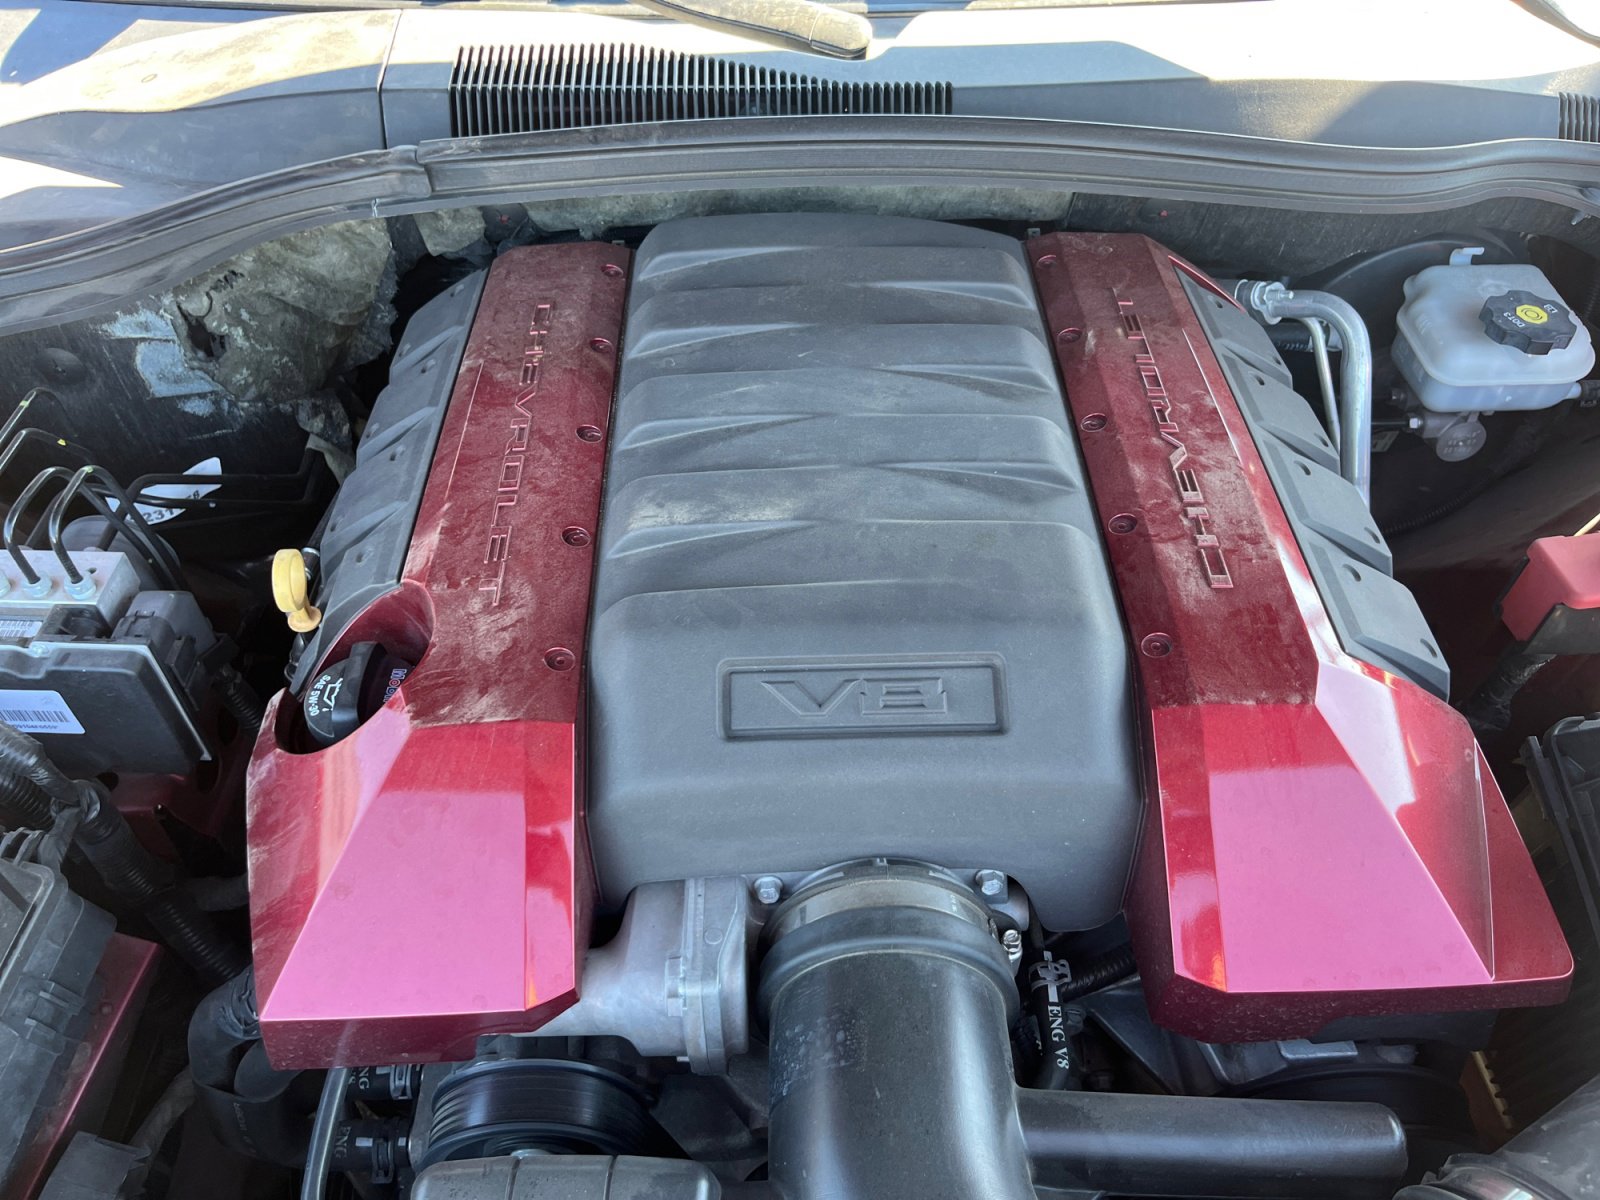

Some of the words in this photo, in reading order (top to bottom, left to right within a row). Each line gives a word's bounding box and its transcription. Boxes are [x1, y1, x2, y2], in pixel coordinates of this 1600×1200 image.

[1503, 311, 1526, 328] DOT3
[1111, 286, 1234, 590] CHEVROLET
[478, 304, 551, 607] CHEVROLET
[313, 674, 332, 690] SAE
[308, 690, 321, 717] 5W-30
[760, 676, 948, 717] V8
[1047, 1005, 1066, 1042] ENG
[1054, 1047, 1070, 1070] V8
[358, 1066, 370, 1090] NG
